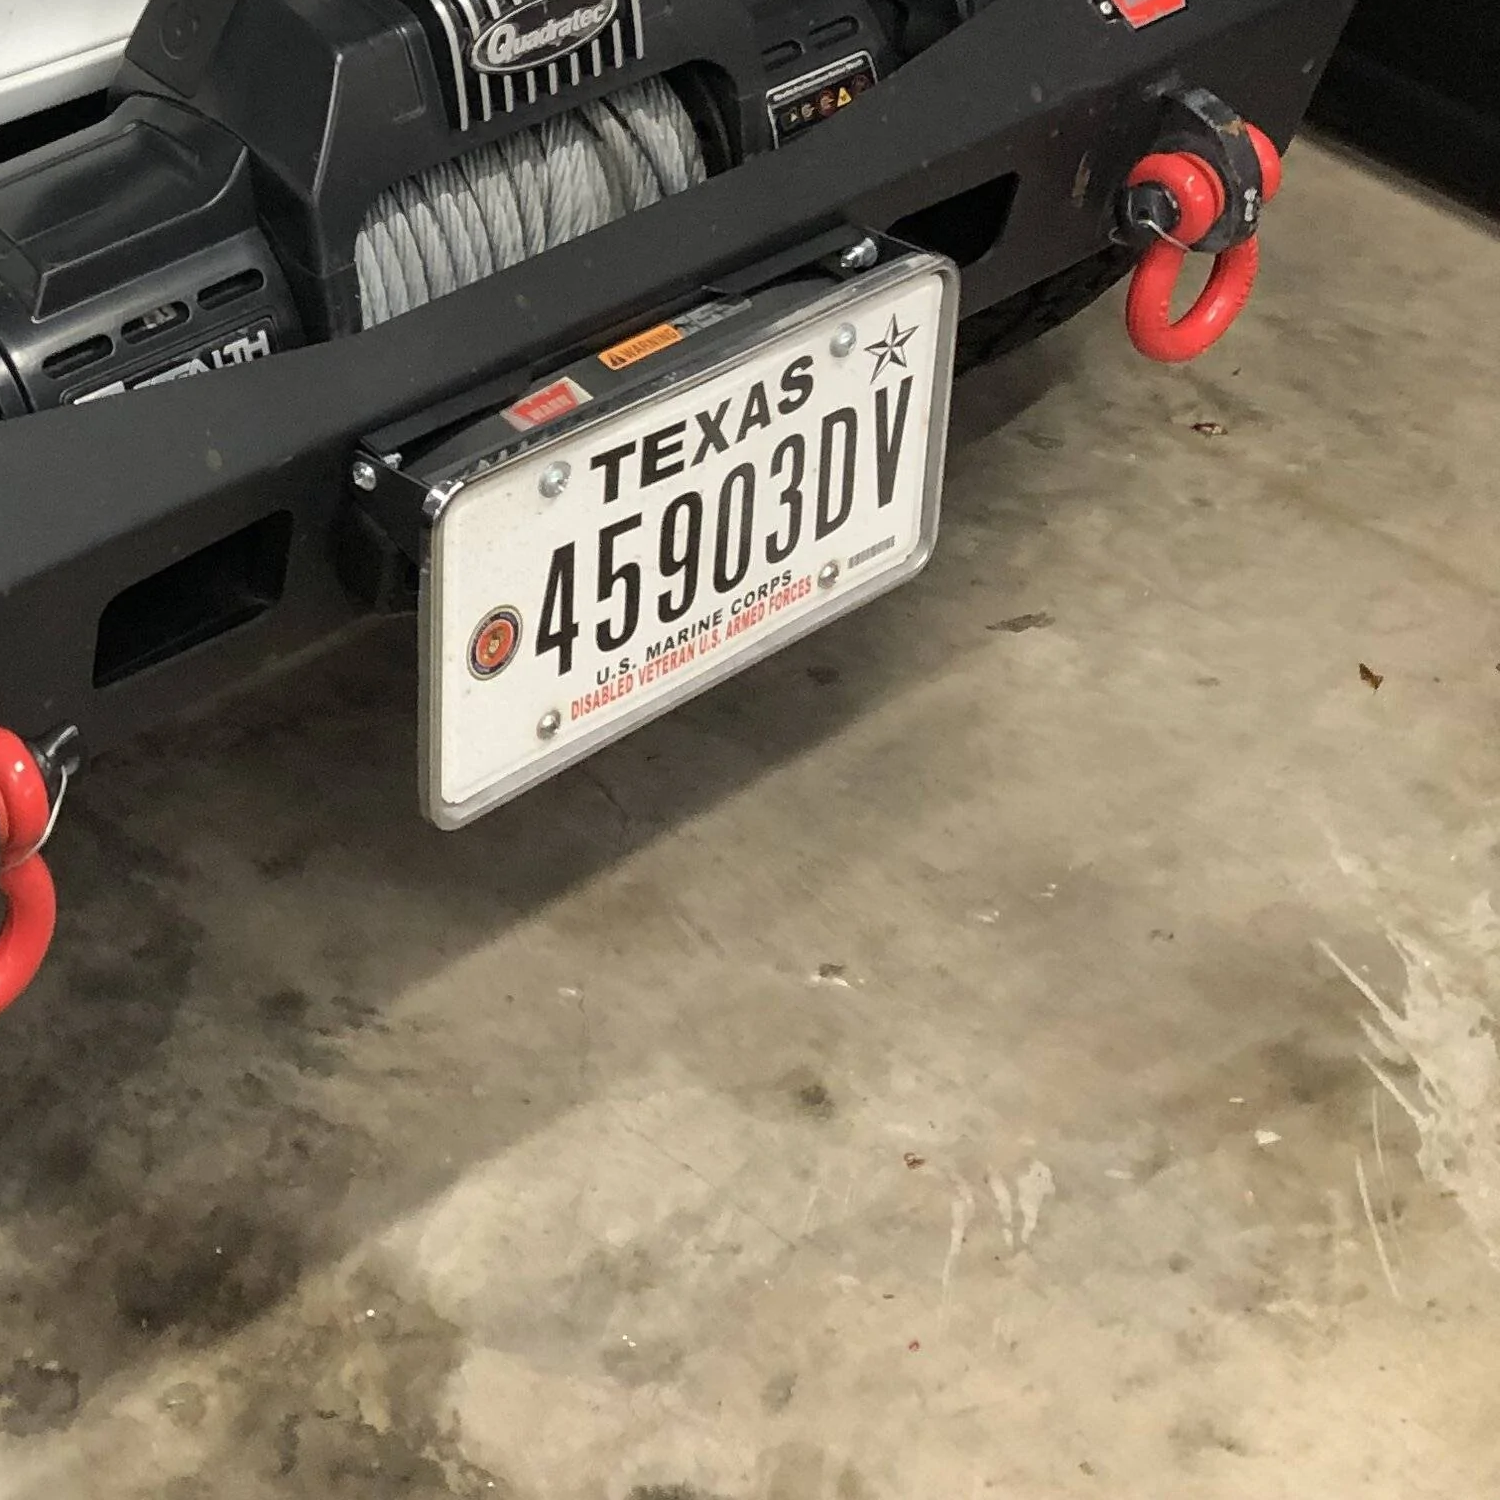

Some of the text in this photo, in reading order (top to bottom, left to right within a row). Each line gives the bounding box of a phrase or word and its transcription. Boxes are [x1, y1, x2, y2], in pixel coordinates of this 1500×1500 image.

[487, 4, 607, 65] Quadratec
[622, 327, 678, 359] WARNING
[590, 355, 814, 504] TEXAS
[534, 376, 914, 676] 45903DV
[571, 574, 812, 721] DISABLED VETERAN U.S. ARMED FORCES
[596, 569, 792, 686] U.S. MARINE CORPS
